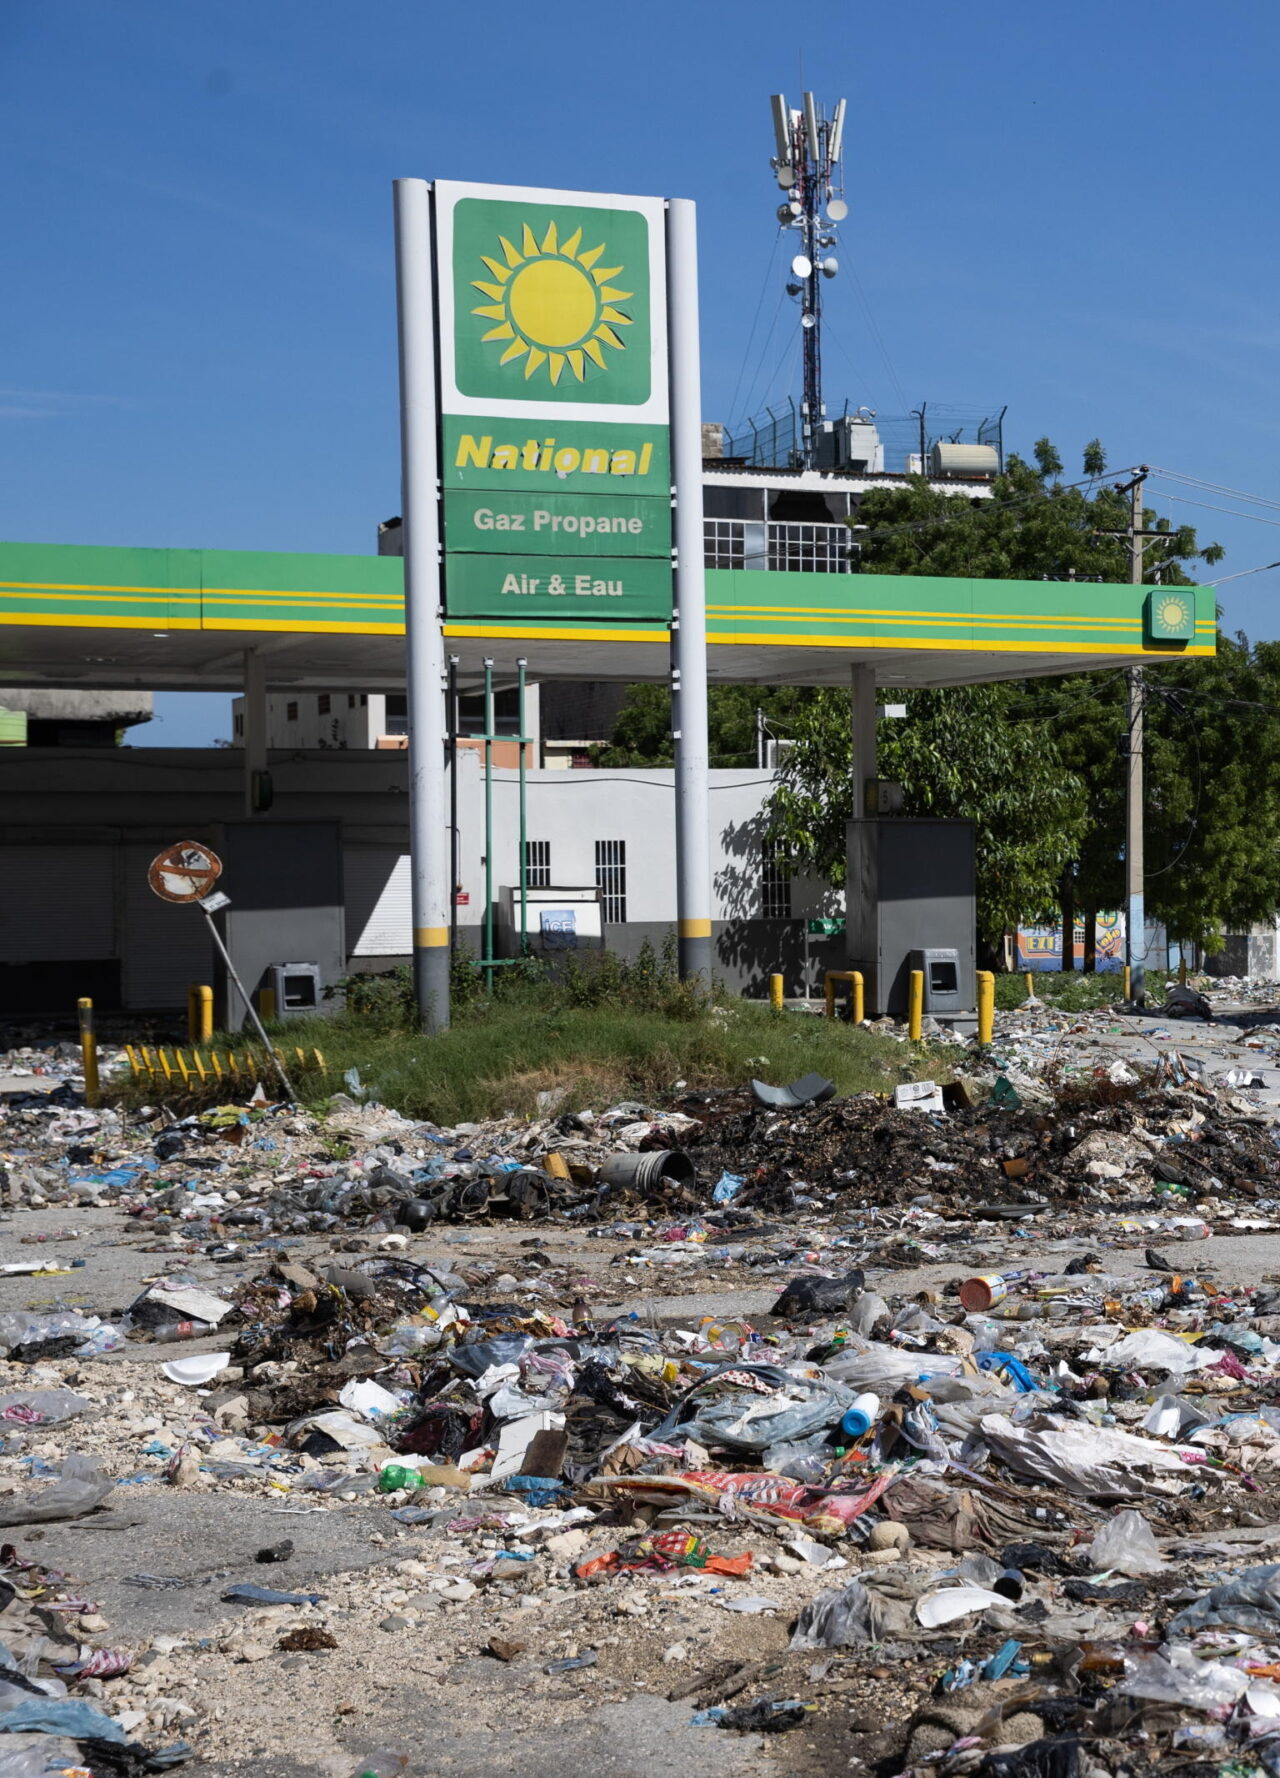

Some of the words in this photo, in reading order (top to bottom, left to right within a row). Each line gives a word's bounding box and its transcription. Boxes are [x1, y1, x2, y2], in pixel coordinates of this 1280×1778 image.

[455, 434, 654, 476] National
[473, 508, 526, 531] Gaz
[533, 510, 643, 538] Propane
[501, 573, 541, 595] Air
[548, 574, 567, 596] &
[575, 575, 623, 596] Eau
